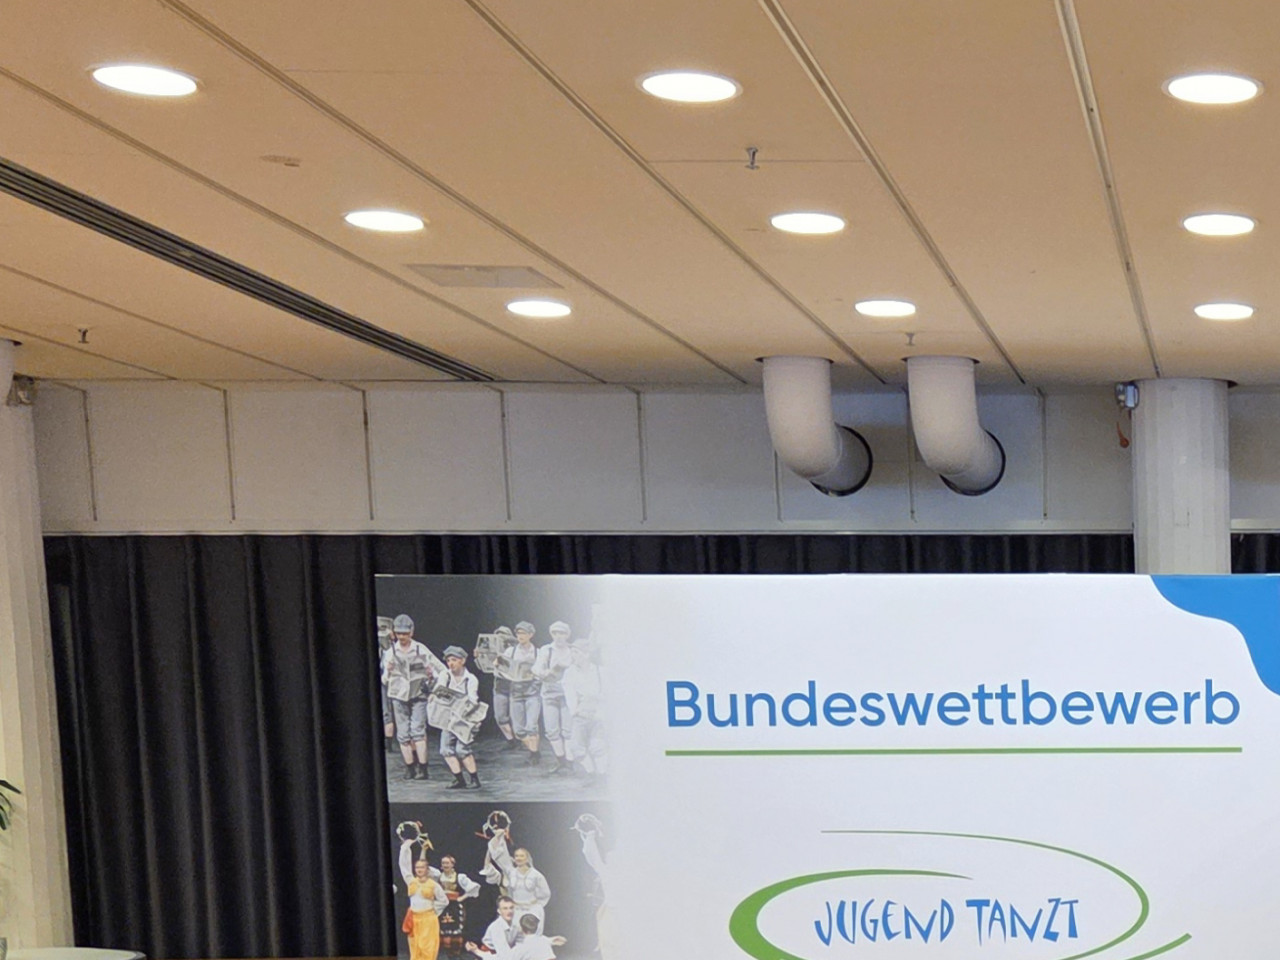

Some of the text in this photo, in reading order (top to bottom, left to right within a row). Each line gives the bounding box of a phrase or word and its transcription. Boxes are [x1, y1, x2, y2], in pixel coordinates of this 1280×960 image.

[665, 679, 1240, 727] Bundeswettbewerb
[814, 897, 1079, 947] JUGEND TANZT
